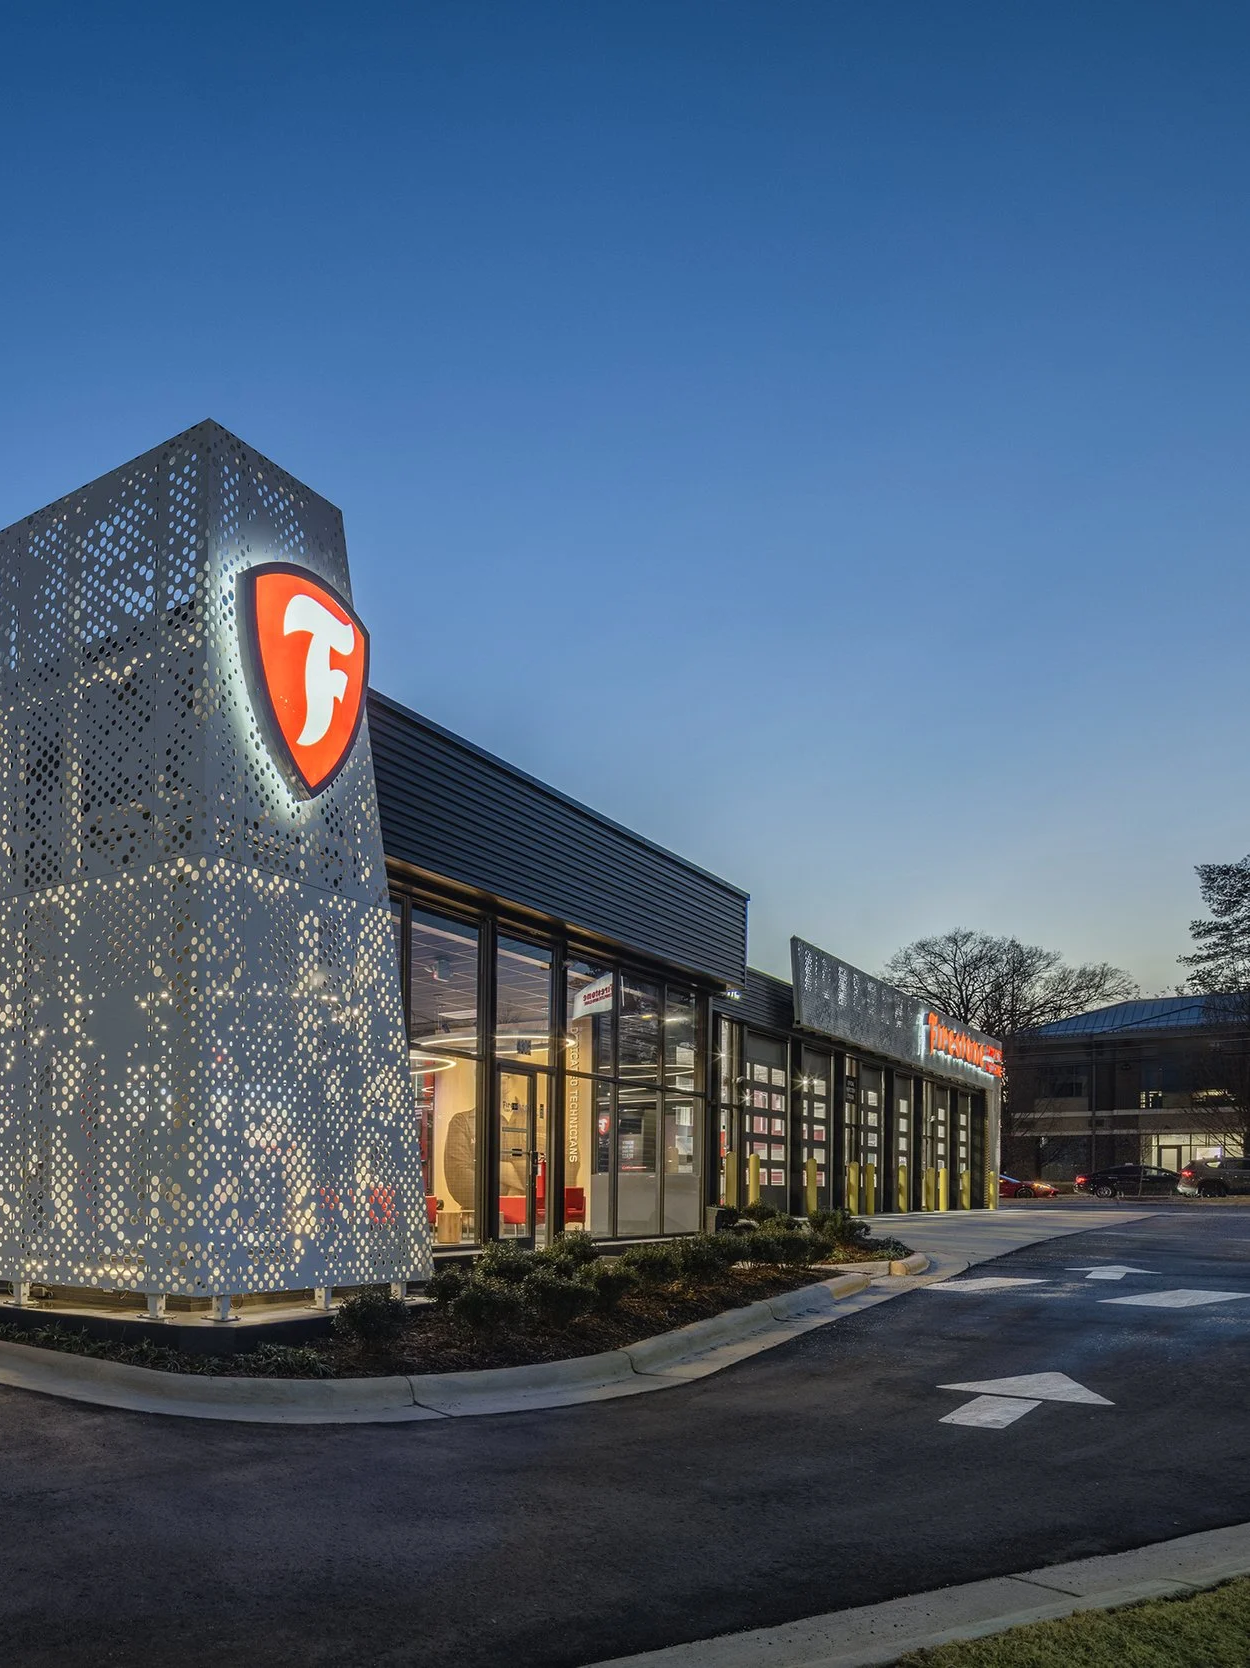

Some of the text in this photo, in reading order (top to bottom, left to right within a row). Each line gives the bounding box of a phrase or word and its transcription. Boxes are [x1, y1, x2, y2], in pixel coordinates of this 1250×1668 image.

[284, 594, 355, 747] F
[928, 1012, 985, 1070] Firestone
[569, 1091, 579, 1163] TECHNICIANS
